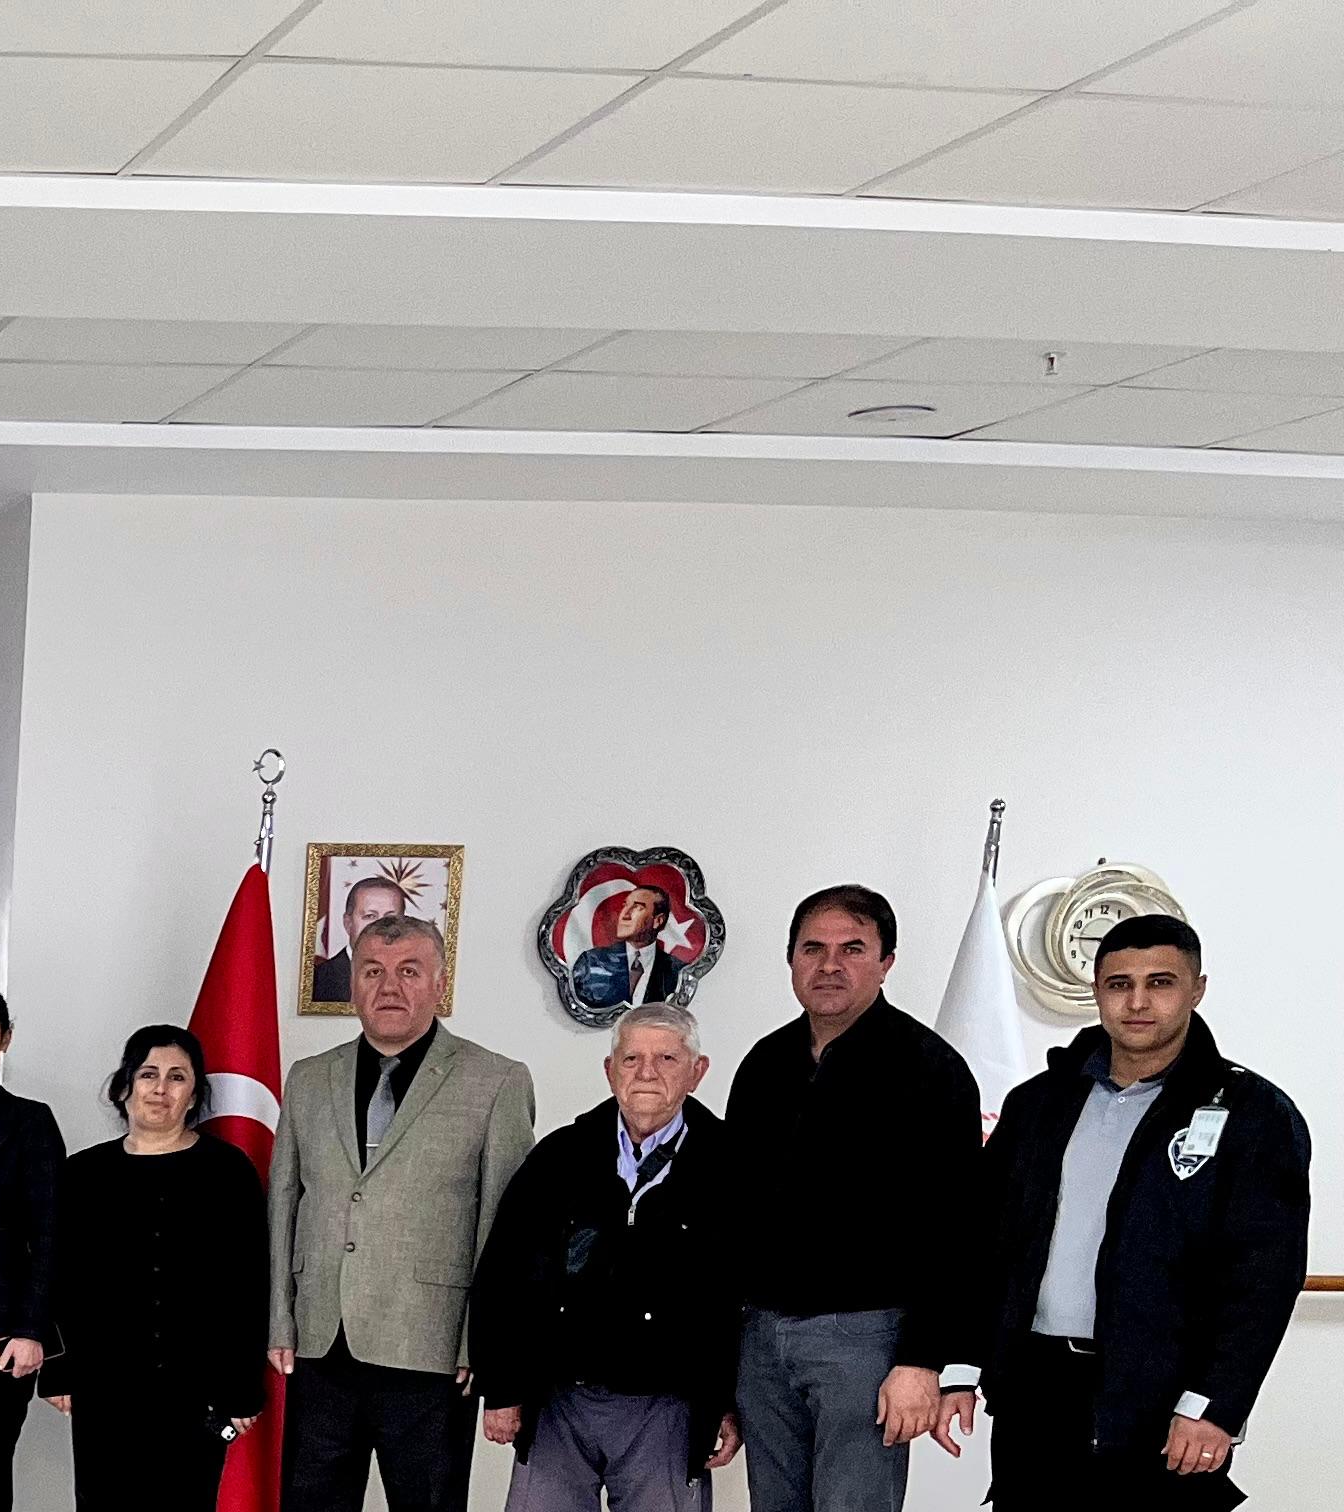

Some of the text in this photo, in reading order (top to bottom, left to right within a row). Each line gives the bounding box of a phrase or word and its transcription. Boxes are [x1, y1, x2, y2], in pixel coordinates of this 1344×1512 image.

[1084, 908, 1093, 919] 11
[1101, 905, 1109, 915] 12
[1081, 961, 1086, 970] 7
